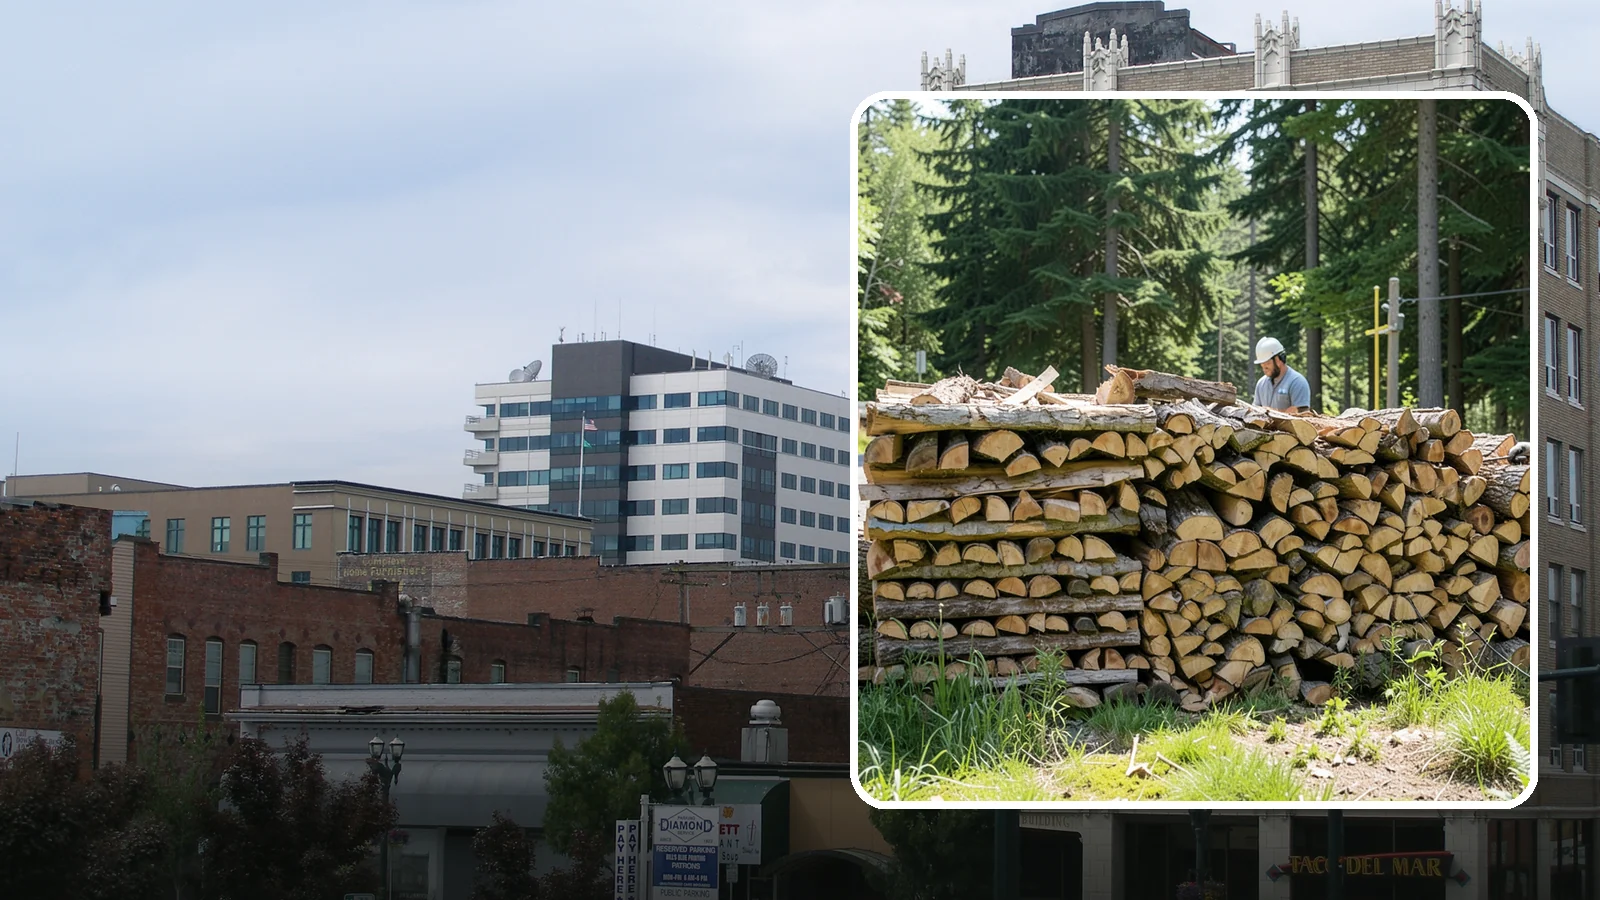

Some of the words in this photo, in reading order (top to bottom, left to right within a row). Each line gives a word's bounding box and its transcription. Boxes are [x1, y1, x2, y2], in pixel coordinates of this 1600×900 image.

[343, 568, 368, 577] Home
[370, 566, 427, 577] Furnishers
[660, 818, 713, 832] DIAMOND
[1022, 815, 1070, 828] BUILDING
[617, 825, 625, 852] PAY
[629, 825, 637, 852] PAY
[656, 845, 688, 853] RESERVED
[689, 846, 716, 854] PARKING
[721, 851, 739, 861] Soup
[671, 862, 701, 870] PATRONS
[1289, 855, 1329, 874] TAC
[1346, 856, 1384, 875] DEL
[1392, 857, 1442, 877] MAR
[617, 856, 625, 893] HERE
[628, 856, 637, 893] HERE
[684, 890, 710, 898] PARKING
